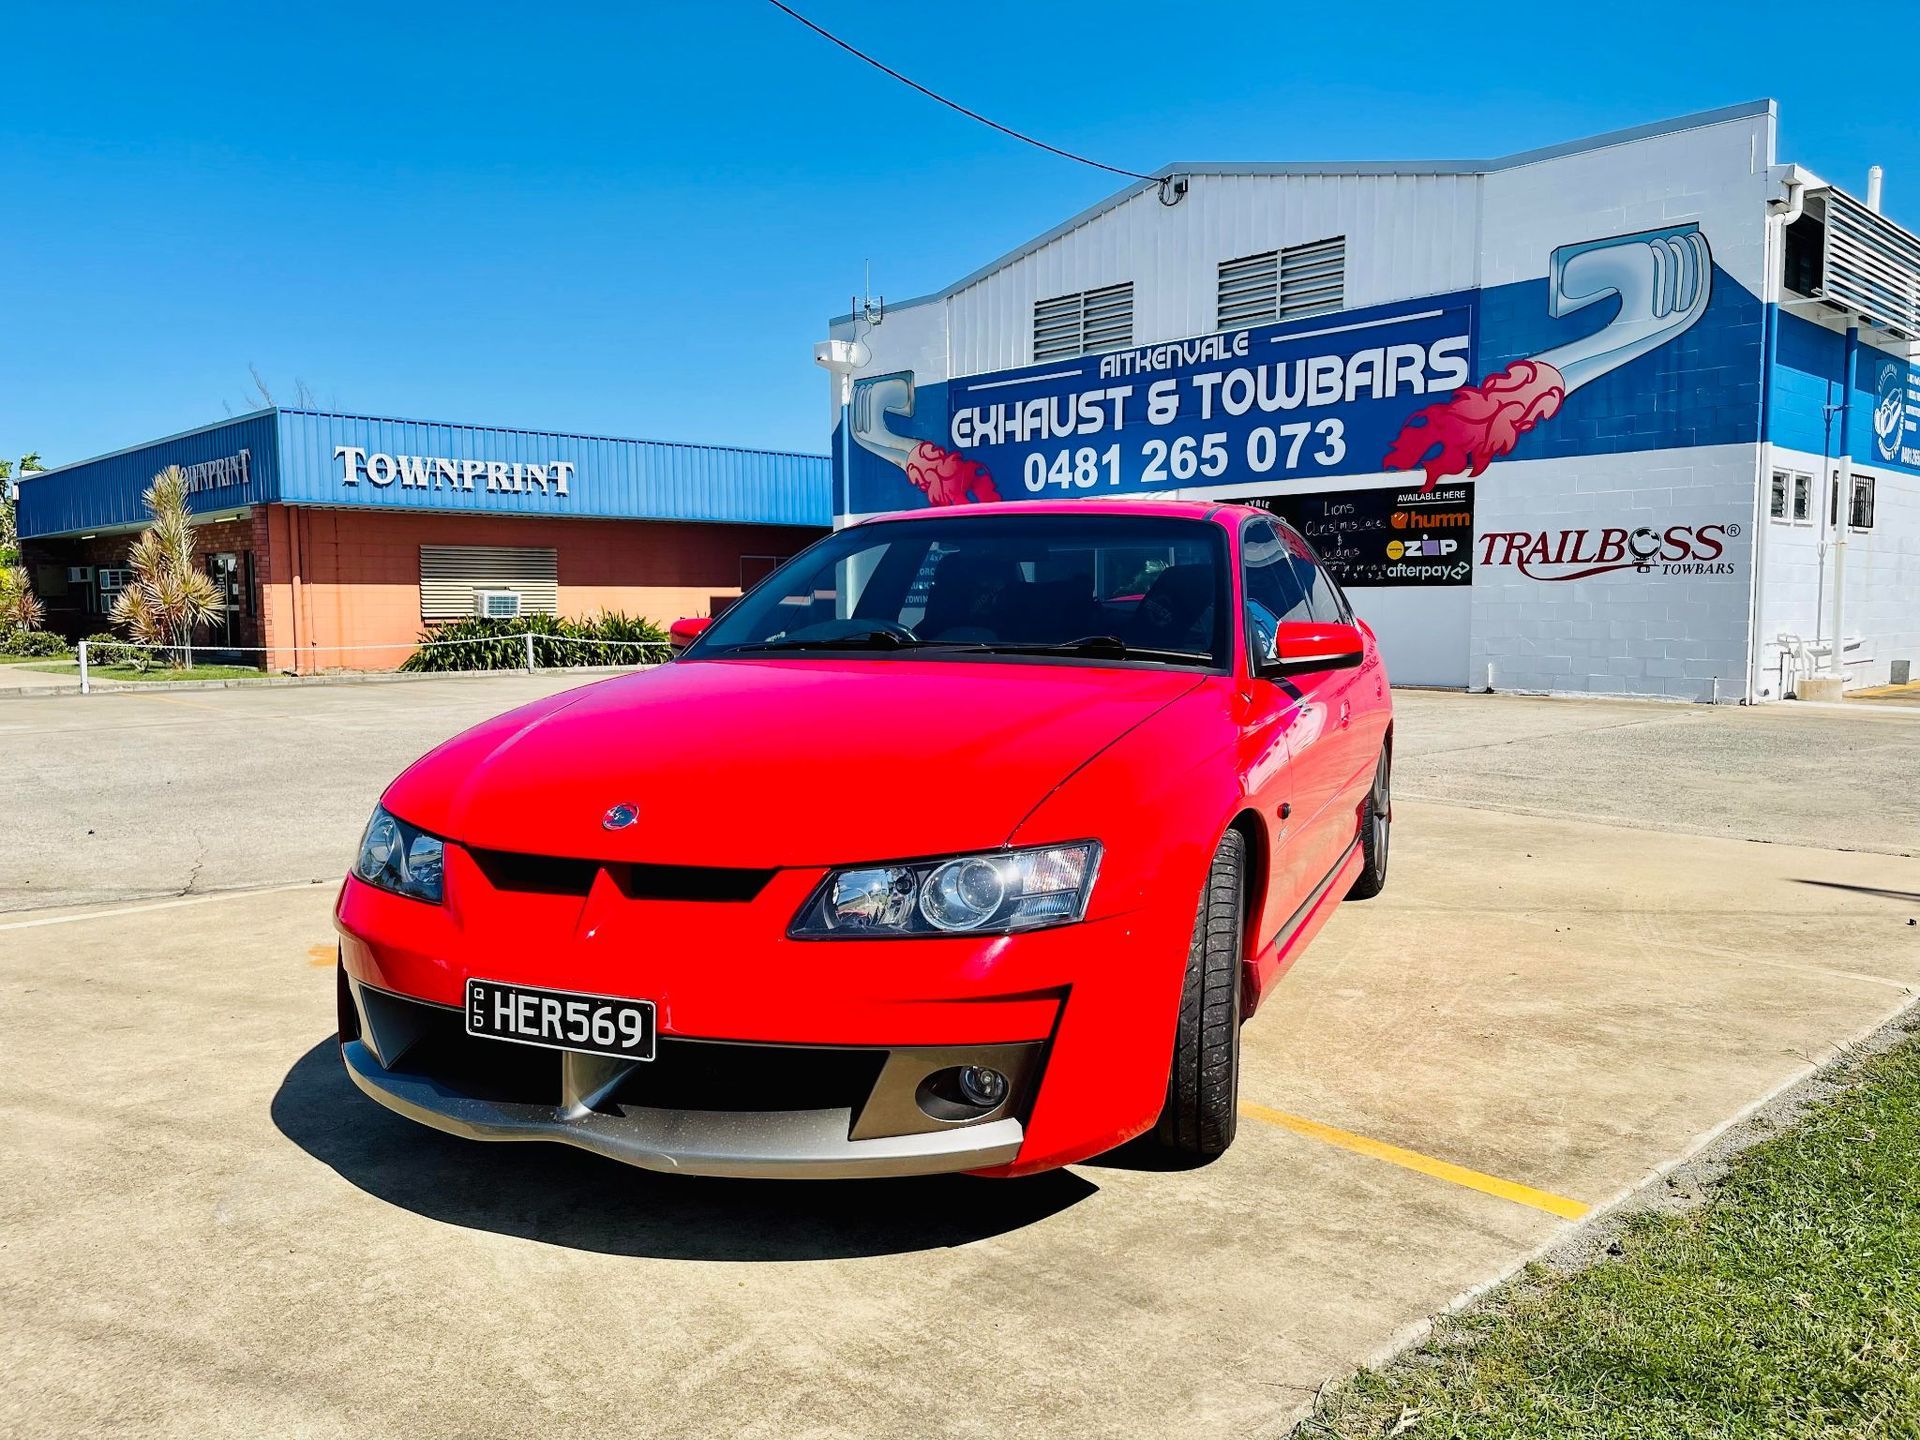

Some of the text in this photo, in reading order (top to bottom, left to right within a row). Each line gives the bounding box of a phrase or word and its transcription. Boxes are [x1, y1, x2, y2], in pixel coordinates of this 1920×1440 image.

[1100, 331, 1249, 379] AITKENVALE
[951, 335, 1469, 447] EXHAUST & TOWBARS
[334, 446, 574, 496] TOWNPRINT
[1024, 418, 1346, 492] 0481 265 073
[1397, 490, 1466, 502] AVAILABLE HERE
[1410, 511, 1470, 529] humm
[1387, 563, 1452, 580] afterpay
[1662, 563, 1735, 575] TOWBARS
[474, 988, 485, 1028] QLD
[494, 991, 642, 1048] HER569
